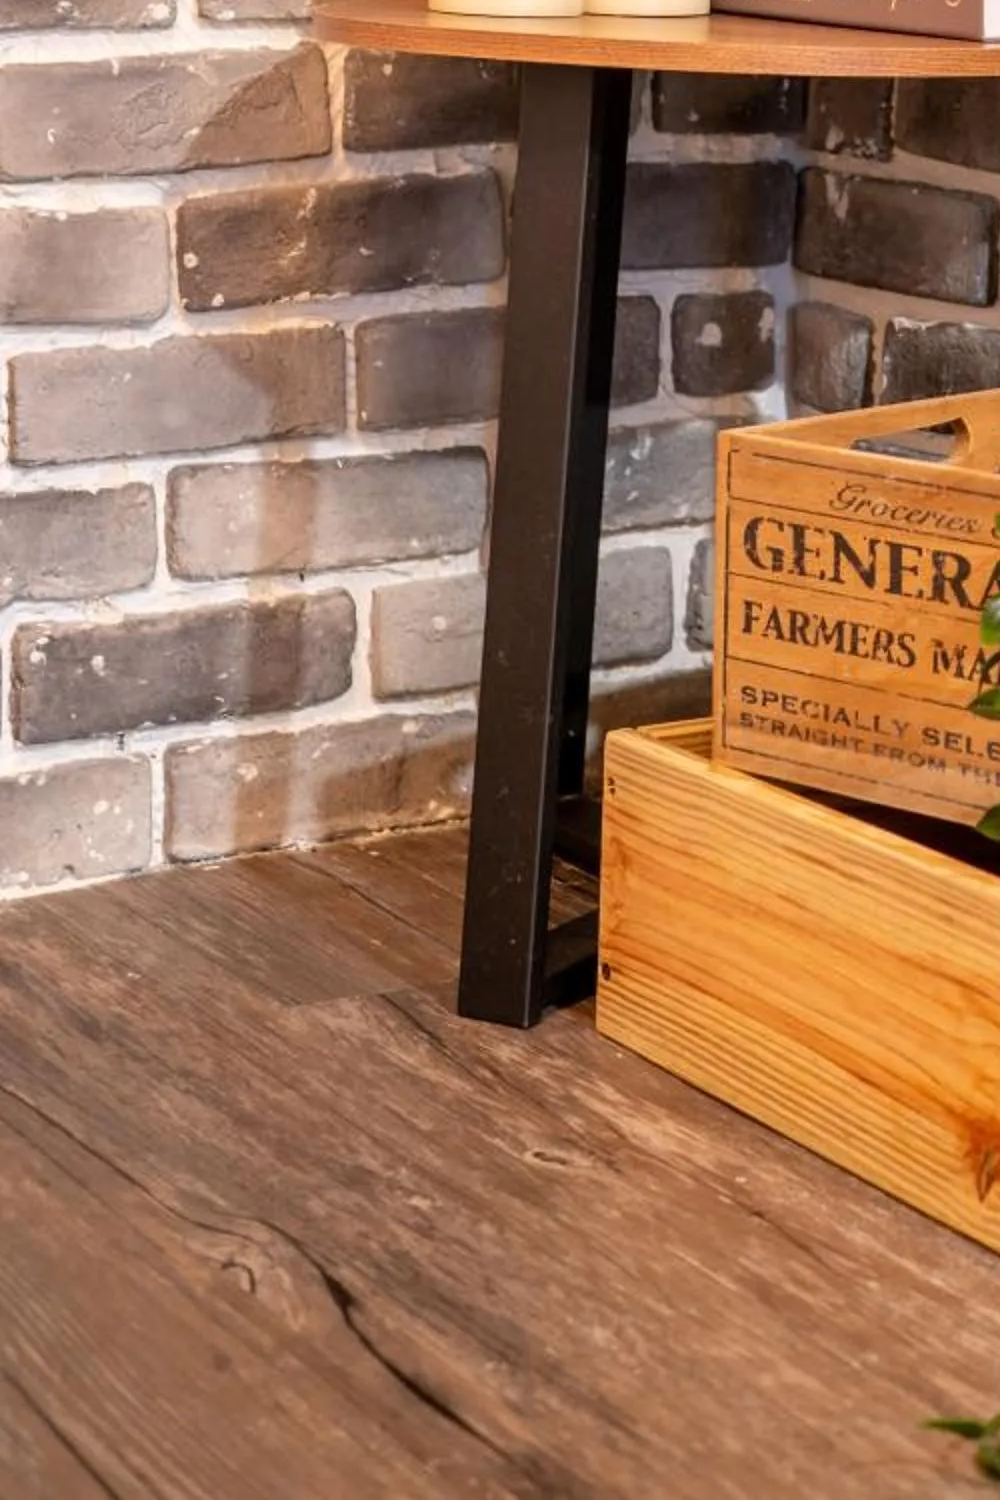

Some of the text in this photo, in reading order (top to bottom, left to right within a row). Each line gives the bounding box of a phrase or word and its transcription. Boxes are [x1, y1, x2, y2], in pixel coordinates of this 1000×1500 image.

[829, 483, 980, 534] Groceries
[741, 599, 917, 669] FARMERS
[739, 685, 911, 739] SPECIALLY
[739, 711, 865, 751] STRAIGHT
[868, 741, 947, 773] FROM
